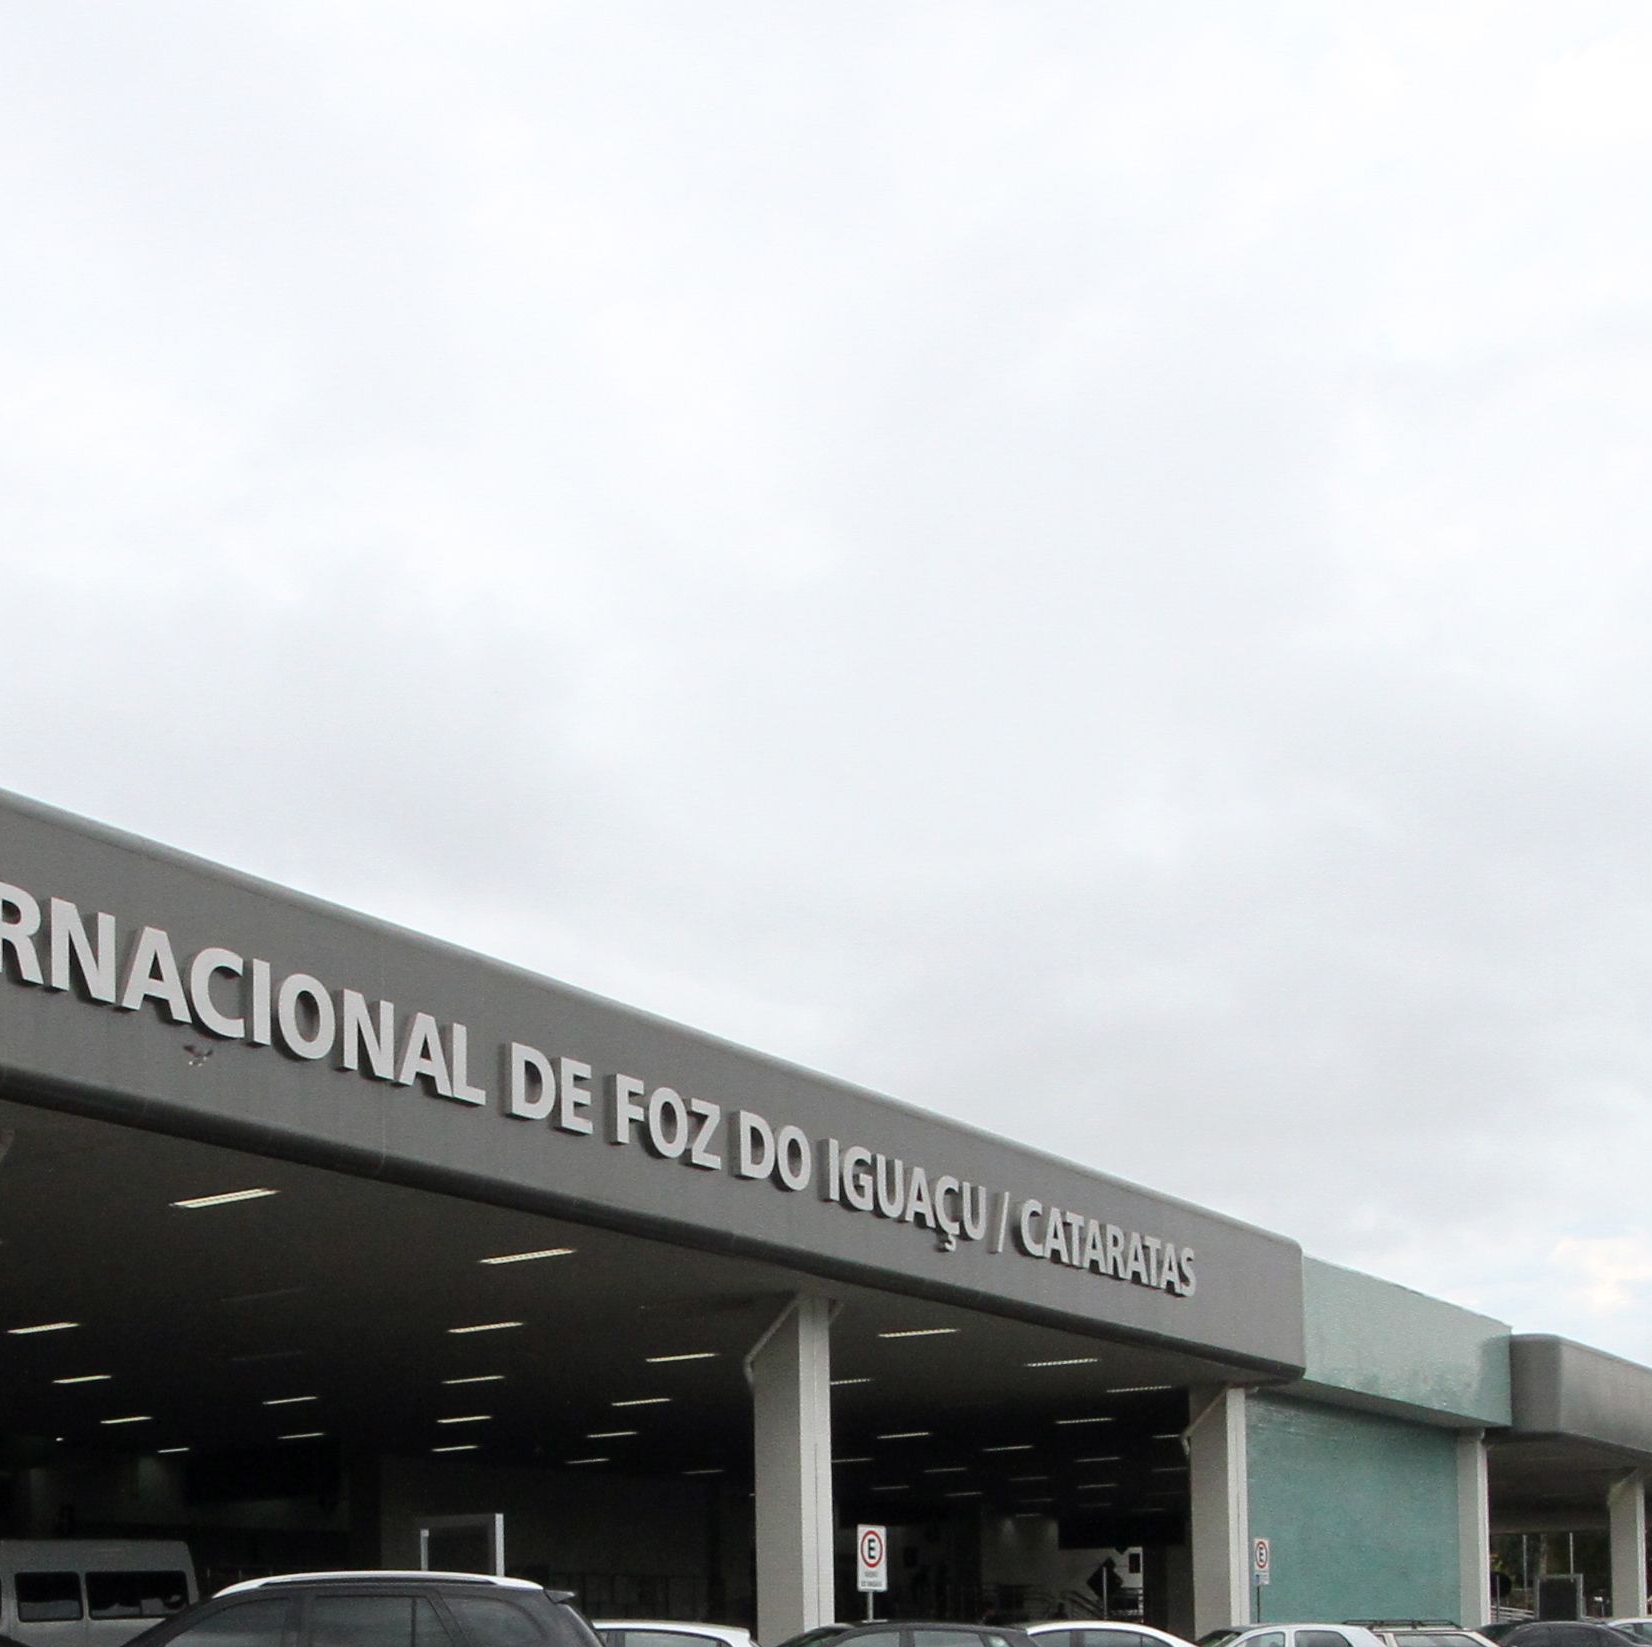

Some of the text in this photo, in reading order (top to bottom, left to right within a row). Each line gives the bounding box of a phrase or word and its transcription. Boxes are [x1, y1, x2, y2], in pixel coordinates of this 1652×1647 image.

[505, 1042, 593, 1135] DE
[611, 1073, 722, 1172] FOZ
[734, 1109, 812, 1193] DO
[821, 1138, 988, 1252] IGUAÇU
[995, 1192, 1010, 1253] /
[1019, 1199, 1197, 1298] CATARATAS
[868, 1538, 876, 1560] E
